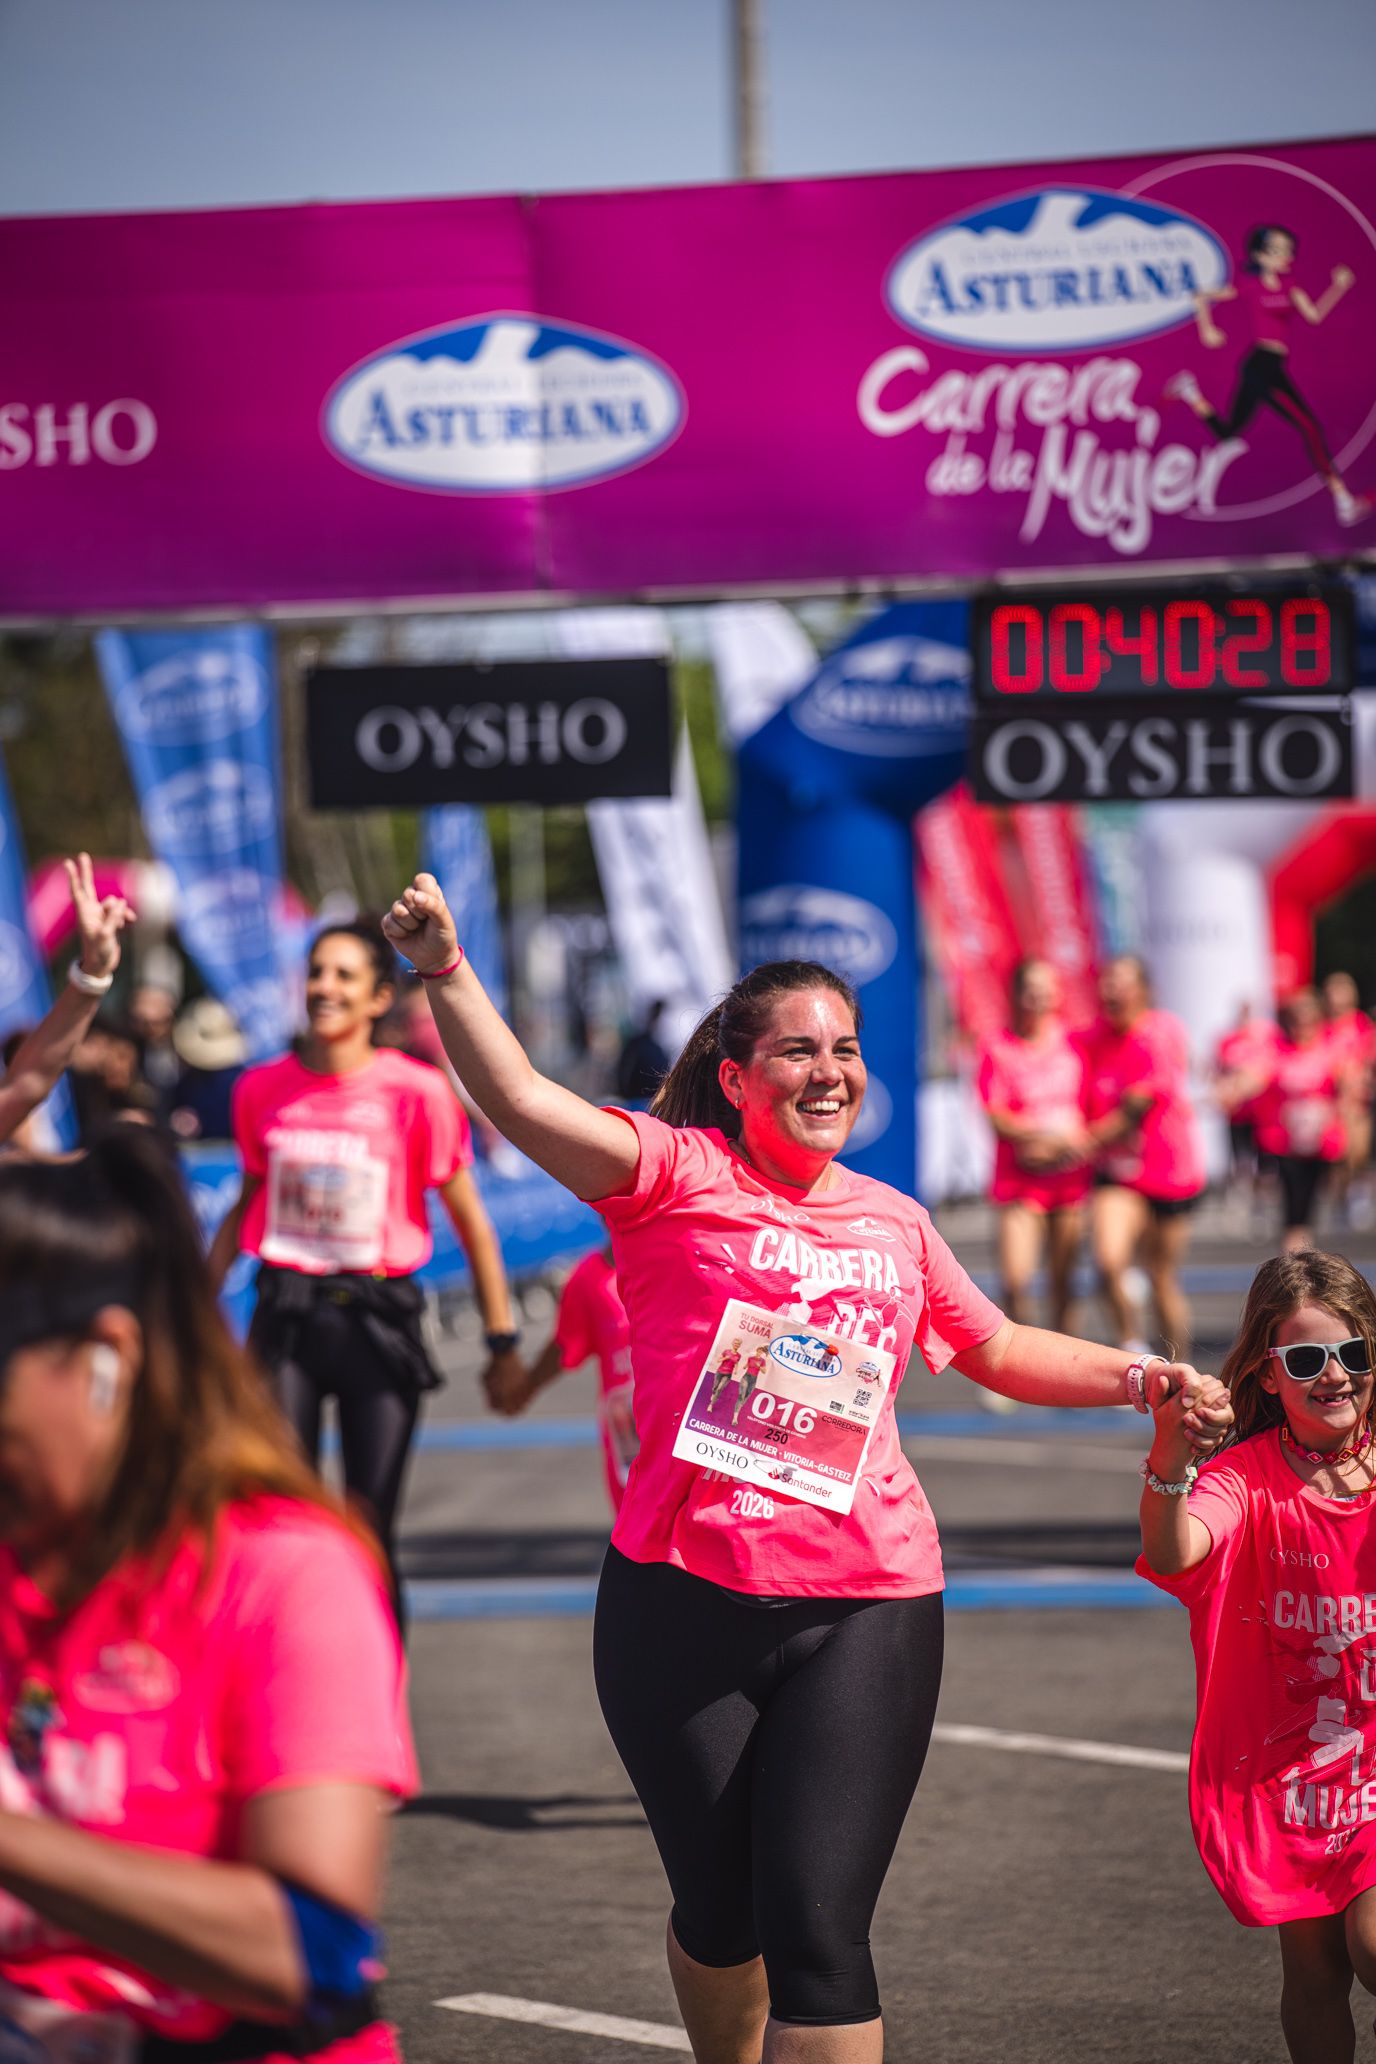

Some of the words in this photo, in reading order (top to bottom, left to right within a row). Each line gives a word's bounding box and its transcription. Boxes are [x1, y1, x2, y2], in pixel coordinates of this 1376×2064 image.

[915, 259, 1200, 317] ASTURIANA
[856, 345, 1142, 437] Carrera
[0, 397, 158, 471] SHO
[356, 386, 650, 455] ASTURIANA
[925, 431, 985, 496] de
[988, 429, 1034, 494] la
[1017, 415, 1249, 556] Mujer
[355, 697, 627, 772] OYSHO
[984, 713, 1342, 799] OYSHO
[738, 1320, 772, 1339] SUMA
[773, 1340, 836, 1374] ASTURIANA
[751, 1392, 818, 1434] 016
[764, 1427, 789, 1445] 250
[821, 1415, 867, 1436] CORREDORA
[689, 1418, 725, 1438] CARRERA
[726, 1431, 739, 1442] DE
[738, 1435, 749, 1446] LA
[750, 1439, 779, 1457] MUJER
[783, 1450, 852, 1482] VITORIA-GASTEIZ
[696, 1441, 749, 1469] OYSHO
[730, 1489, 775, 1519] 2026
[781, 1473, 833, 1498] Santander
